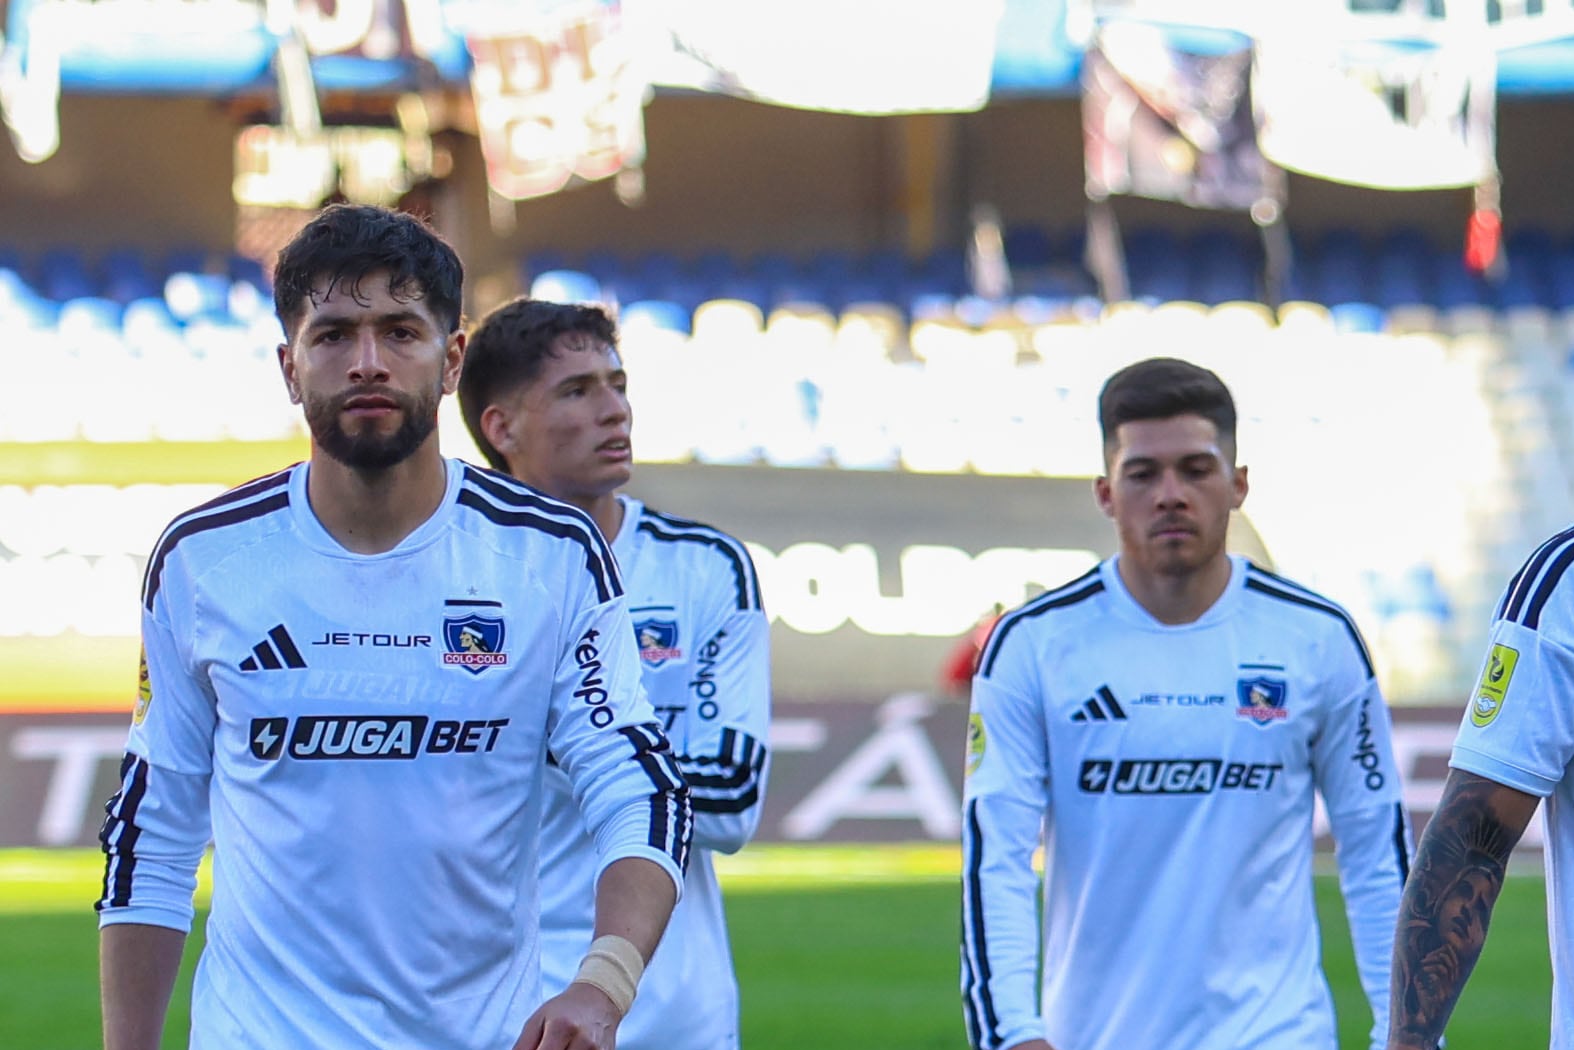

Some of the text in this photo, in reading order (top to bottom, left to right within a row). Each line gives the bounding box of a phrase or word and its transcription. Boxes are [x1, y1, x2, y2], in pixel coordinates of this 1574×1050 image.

[311, 632, 432, 648] JETOUR
[444, 652, 506, 666] COLO-COLO
[1130, 693, 1226, 707] JETOUR
